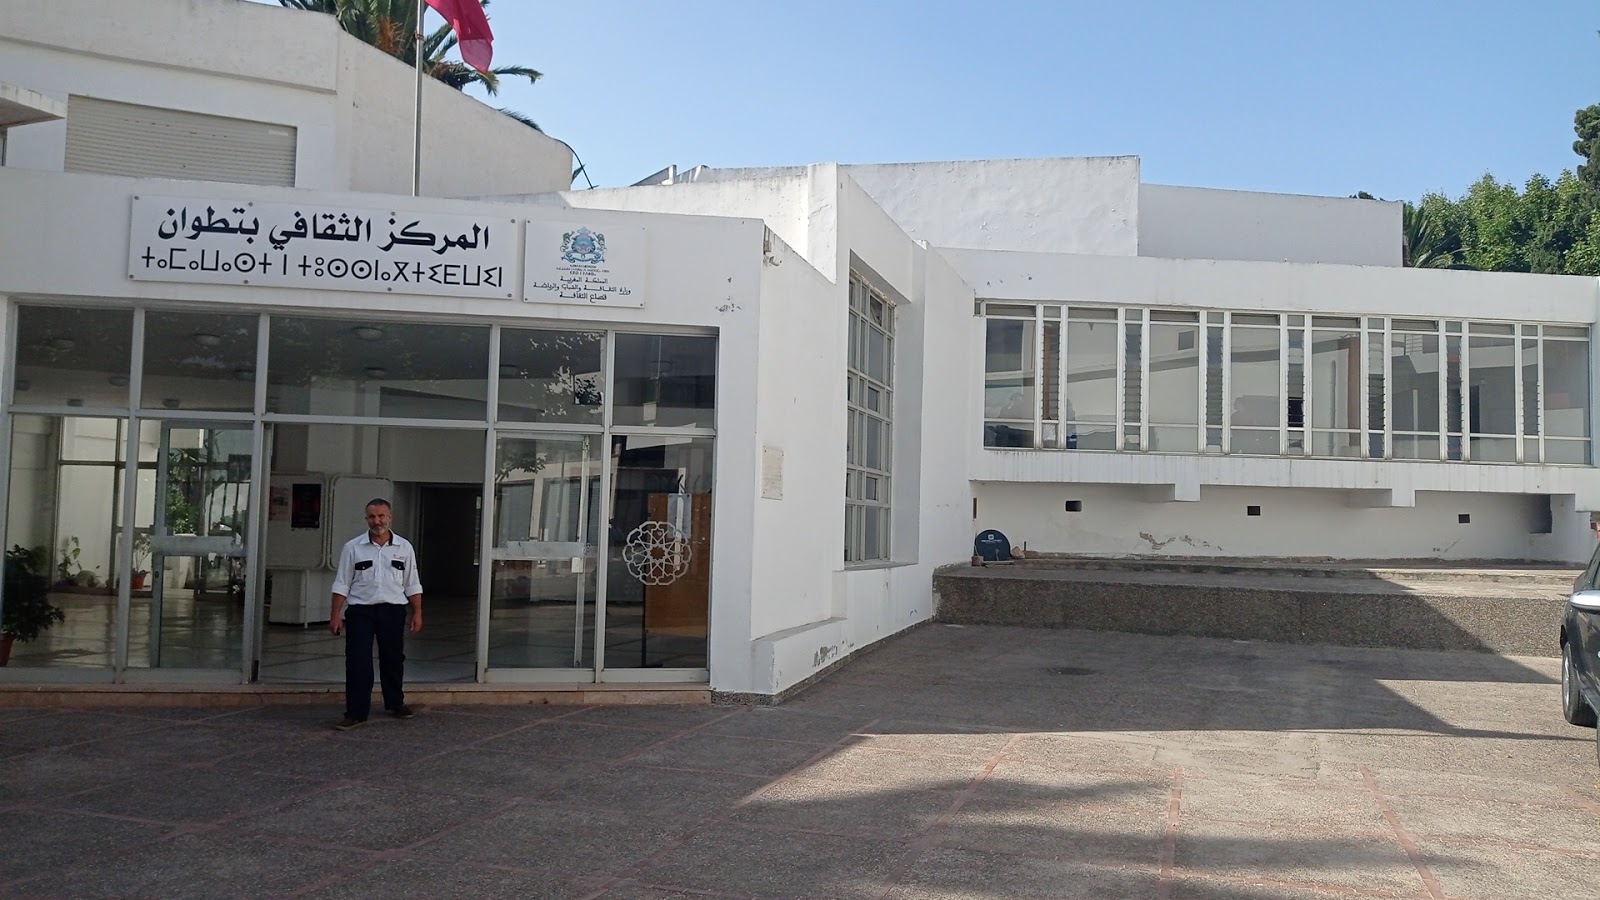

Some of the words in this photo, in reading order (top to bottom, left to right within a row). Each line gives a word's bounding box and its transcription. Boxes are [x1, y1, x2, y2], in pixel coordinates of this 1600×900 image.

[158, 205, 260, 245] بتطوان
[268, 211, 372, 251] الثقافي
[377, 217, 489, 255] المركز
